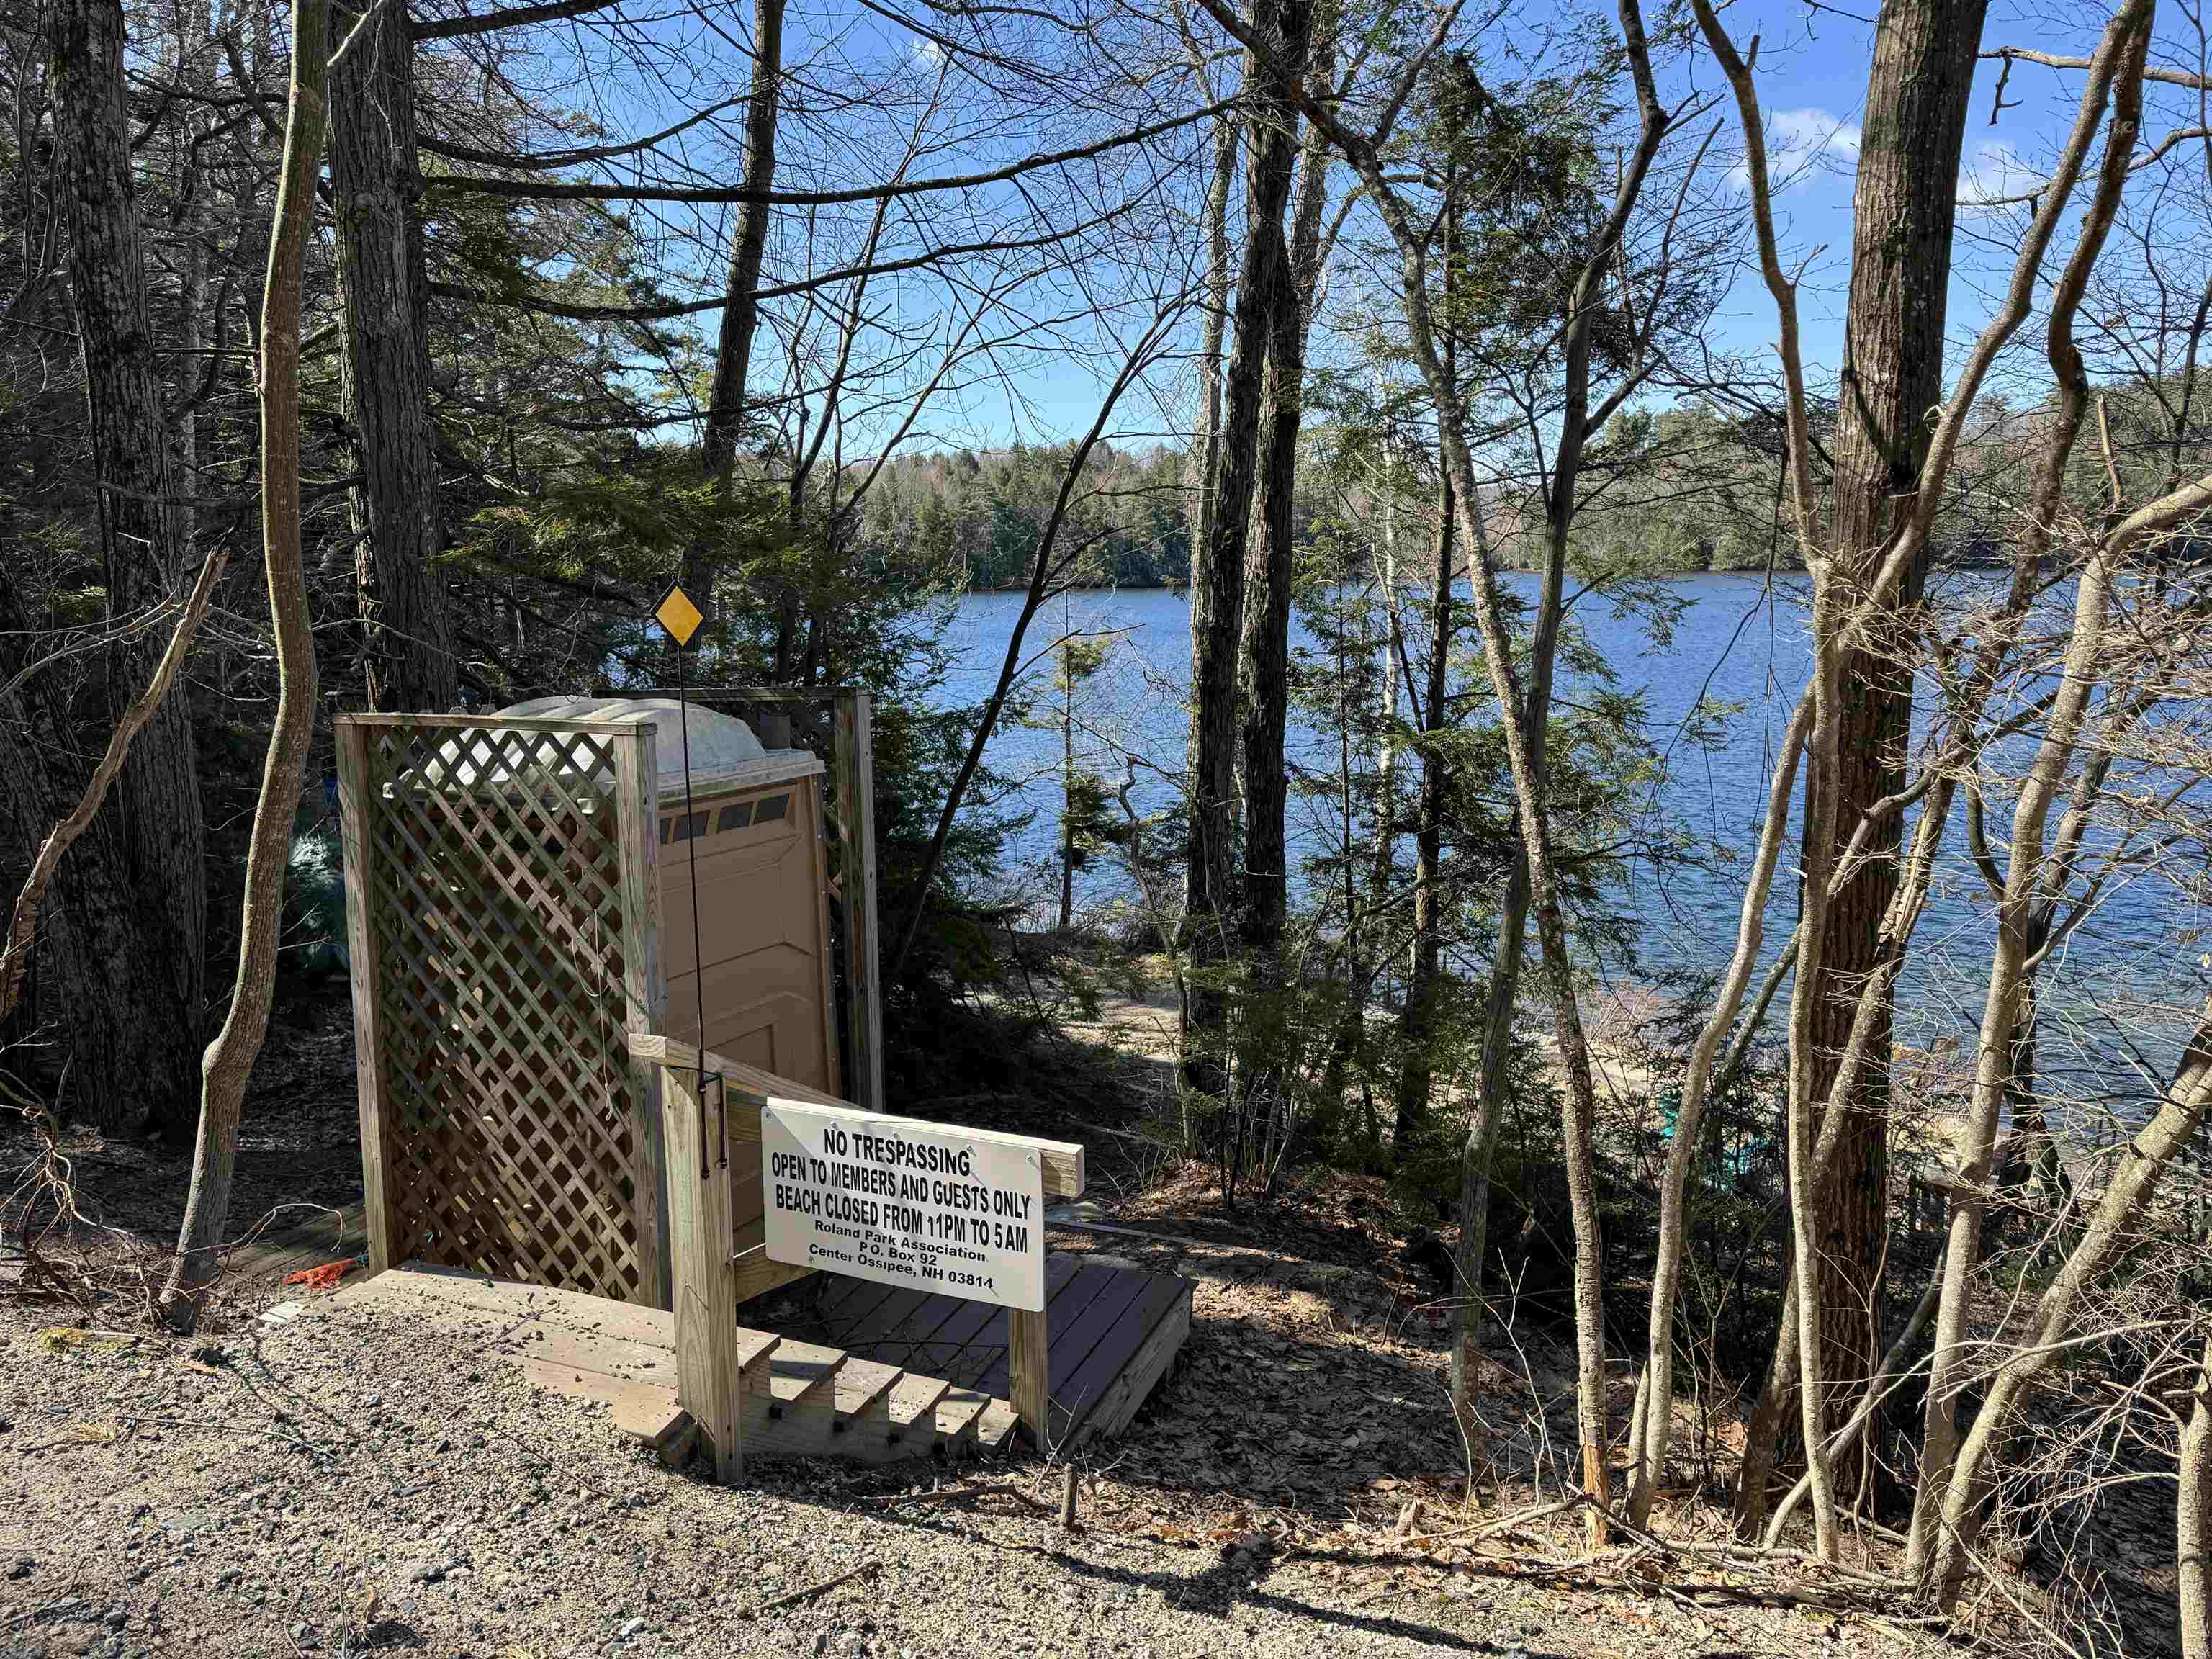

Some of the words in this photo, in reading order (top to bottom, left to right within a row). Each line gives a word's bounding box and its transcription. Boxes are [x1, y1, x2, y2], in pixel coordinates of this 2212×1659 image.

[824, 1129, 847, 1156] NO
[853, 1134, 970, 1176] TRESPASSING
[772, 1152, 806, 1181] OPEN
[810, 1159, 827, 1184] TO
[832, 1163, 896, 1197] MEMBERS
[900, 1174, 928, 1202] AND
[933, 1180, 989, 1213] GUESTS
[994, 1190, 1030, 1220] ONLY
[776, 1184, 820, 1215] BEACH
[825, 1192, 878, 1226] CLOSED
[884, 1205, 922, 1235] FROM
[928, 1213, 966, 1243] 11PM
[971, 1219, 989, 1246] TO
[995, 1224, 1002, 1249] 5
[1005, 1226, 1028, 1253] AM
[815, 1220, 860, 1238] Roland
[866, 1231, 896, 1245] Park
[901, 1237, 986, 1262] Association
[809, 1244, 853, 1262] Center
[858, 1255, 917, 1278] Ossipee,
[922, 1267, 943, 1280] NH
[948, 1272, 993, 1289] 03814
[889, 1247, 914, 1261] Box
[920, 1253, 937, 1265] 92
